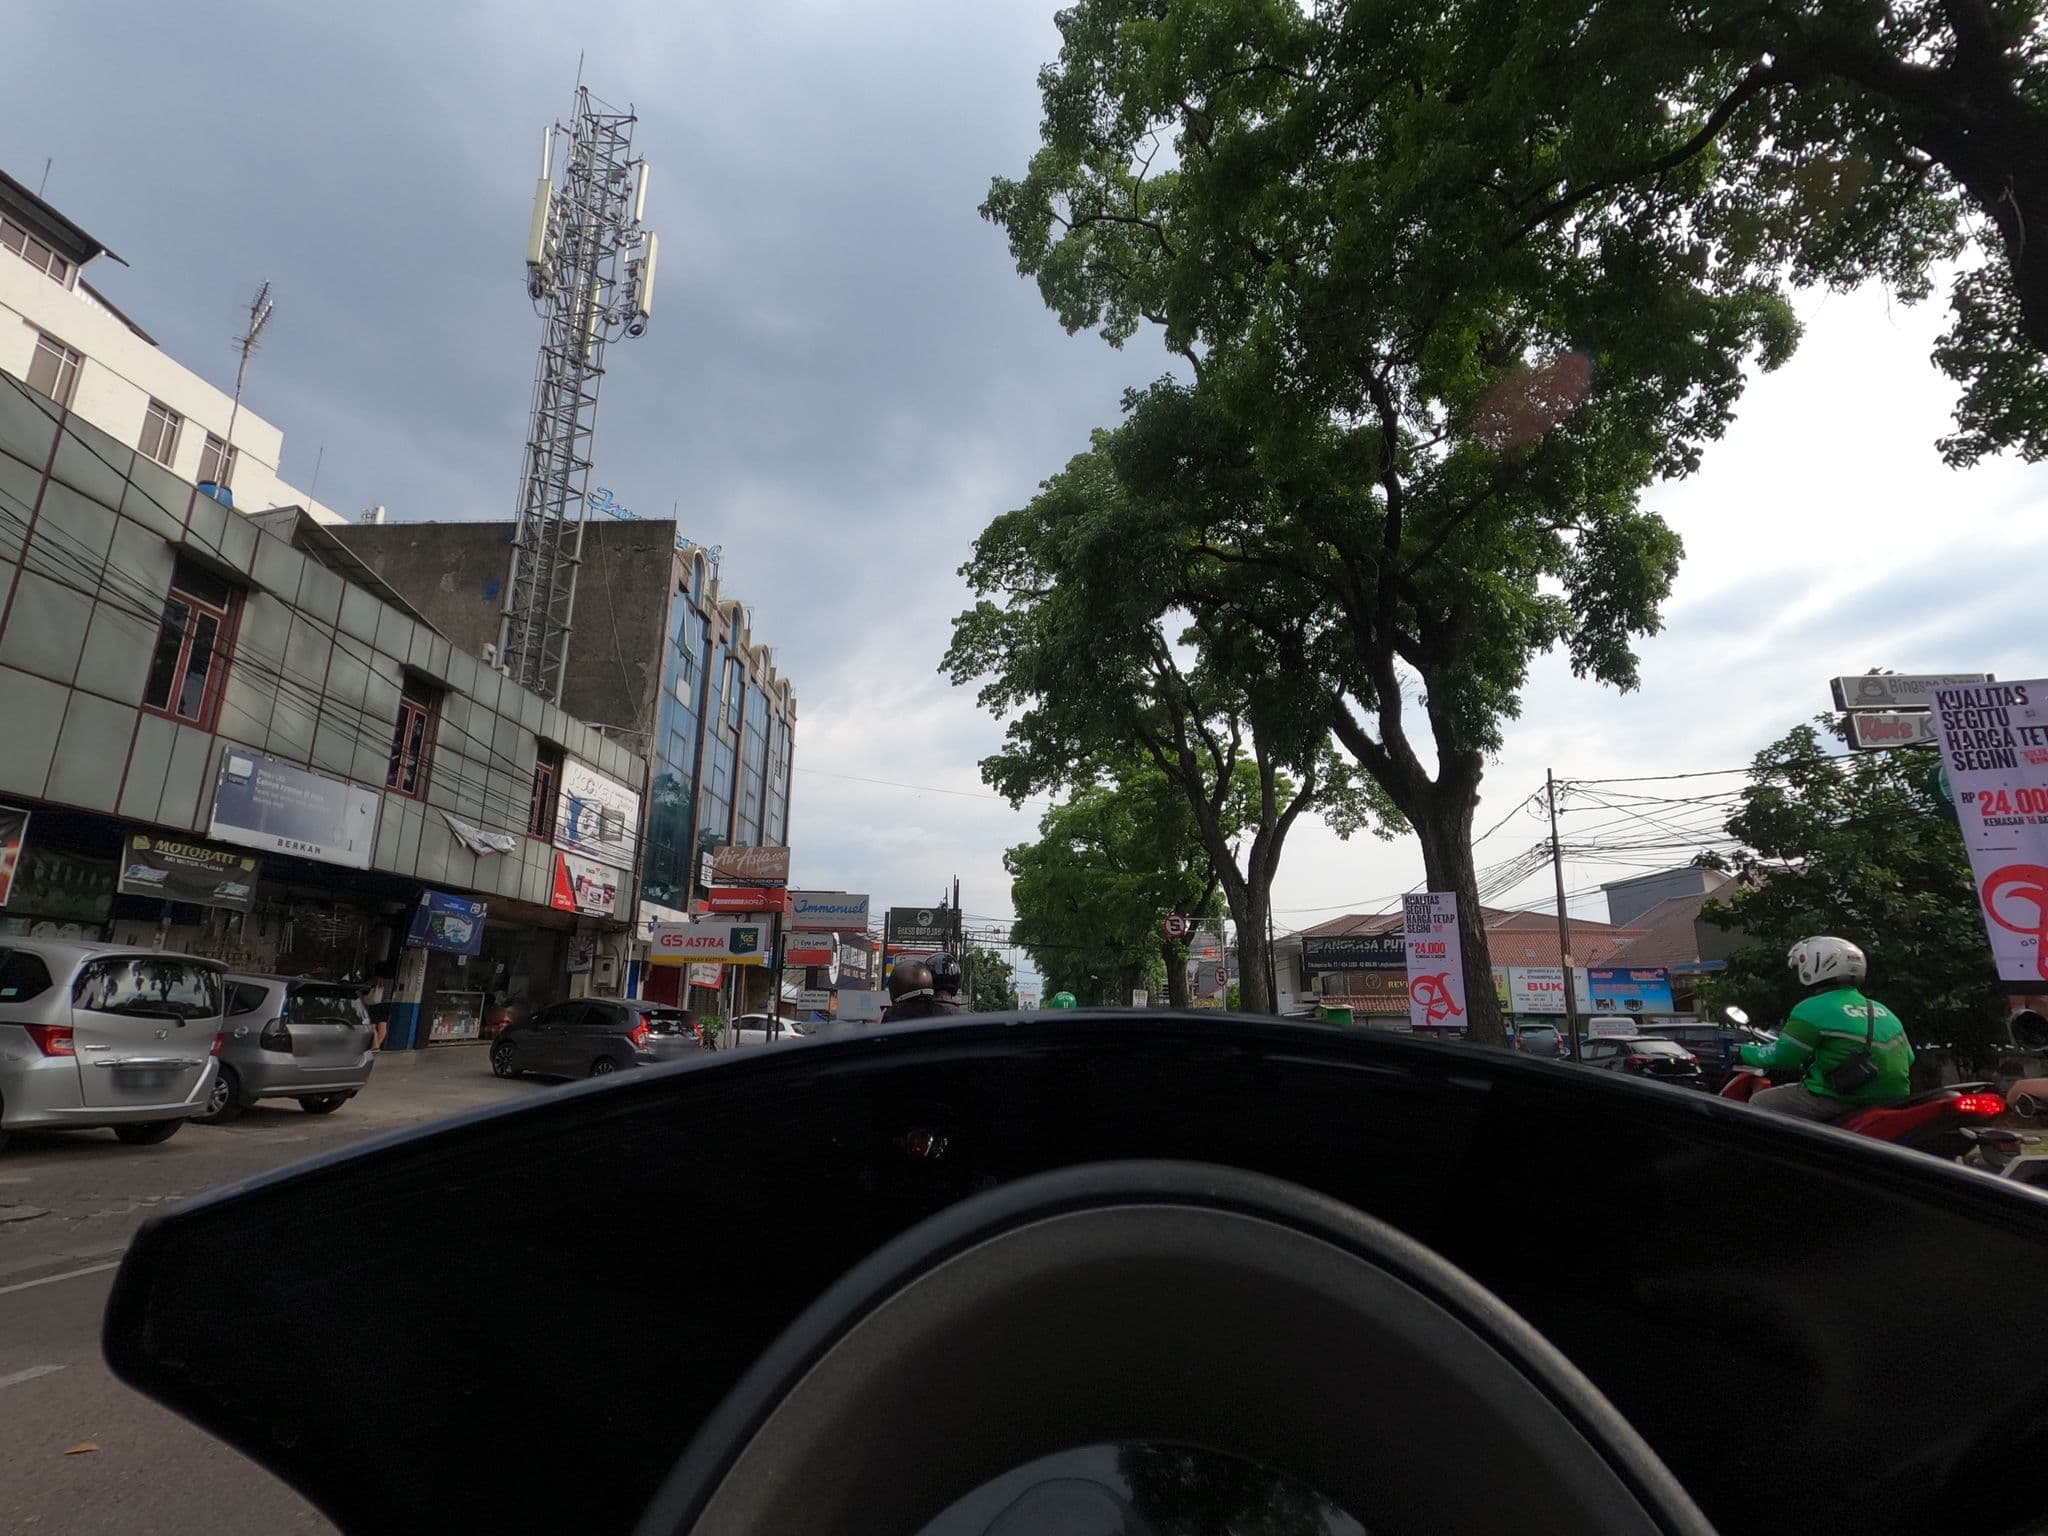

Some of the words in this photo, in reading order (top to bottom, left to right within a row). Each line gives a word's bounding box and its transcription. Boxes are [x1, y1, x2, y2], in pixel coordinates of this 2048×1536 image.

[1936, 685, 2029, 711] KUALITAS
[1941, 708, 2010, 730] SEGITU
[1946, 727, 2018, 750] HARGA
[1952, 748, 2018, 771] SEGINI
[1961, 791, 1975, 804] RP
[155, 838, 237, 865] MOTOBATT
[277, 838, 322, 855] BERKAH
[794, 899, 866, 914] Immanuel
[1405, 895, 1440, 905] KUALITAS
[1406, 905, 1431, 914] SEGITU
[1406, 915, 1432, 924] HARGA
[1433, 914, 1456, 923] TETAP
[1407, 924, 1431, 933] SEGINI
[660, 934, 683, 947] GS
[685, 937, 725, 948] ASTRA
[1324, 939, 1379, 949] ANGKASA
[1415, 942, 1446, 954] 24.000
[1527, 982, 1563, 991] BUK
